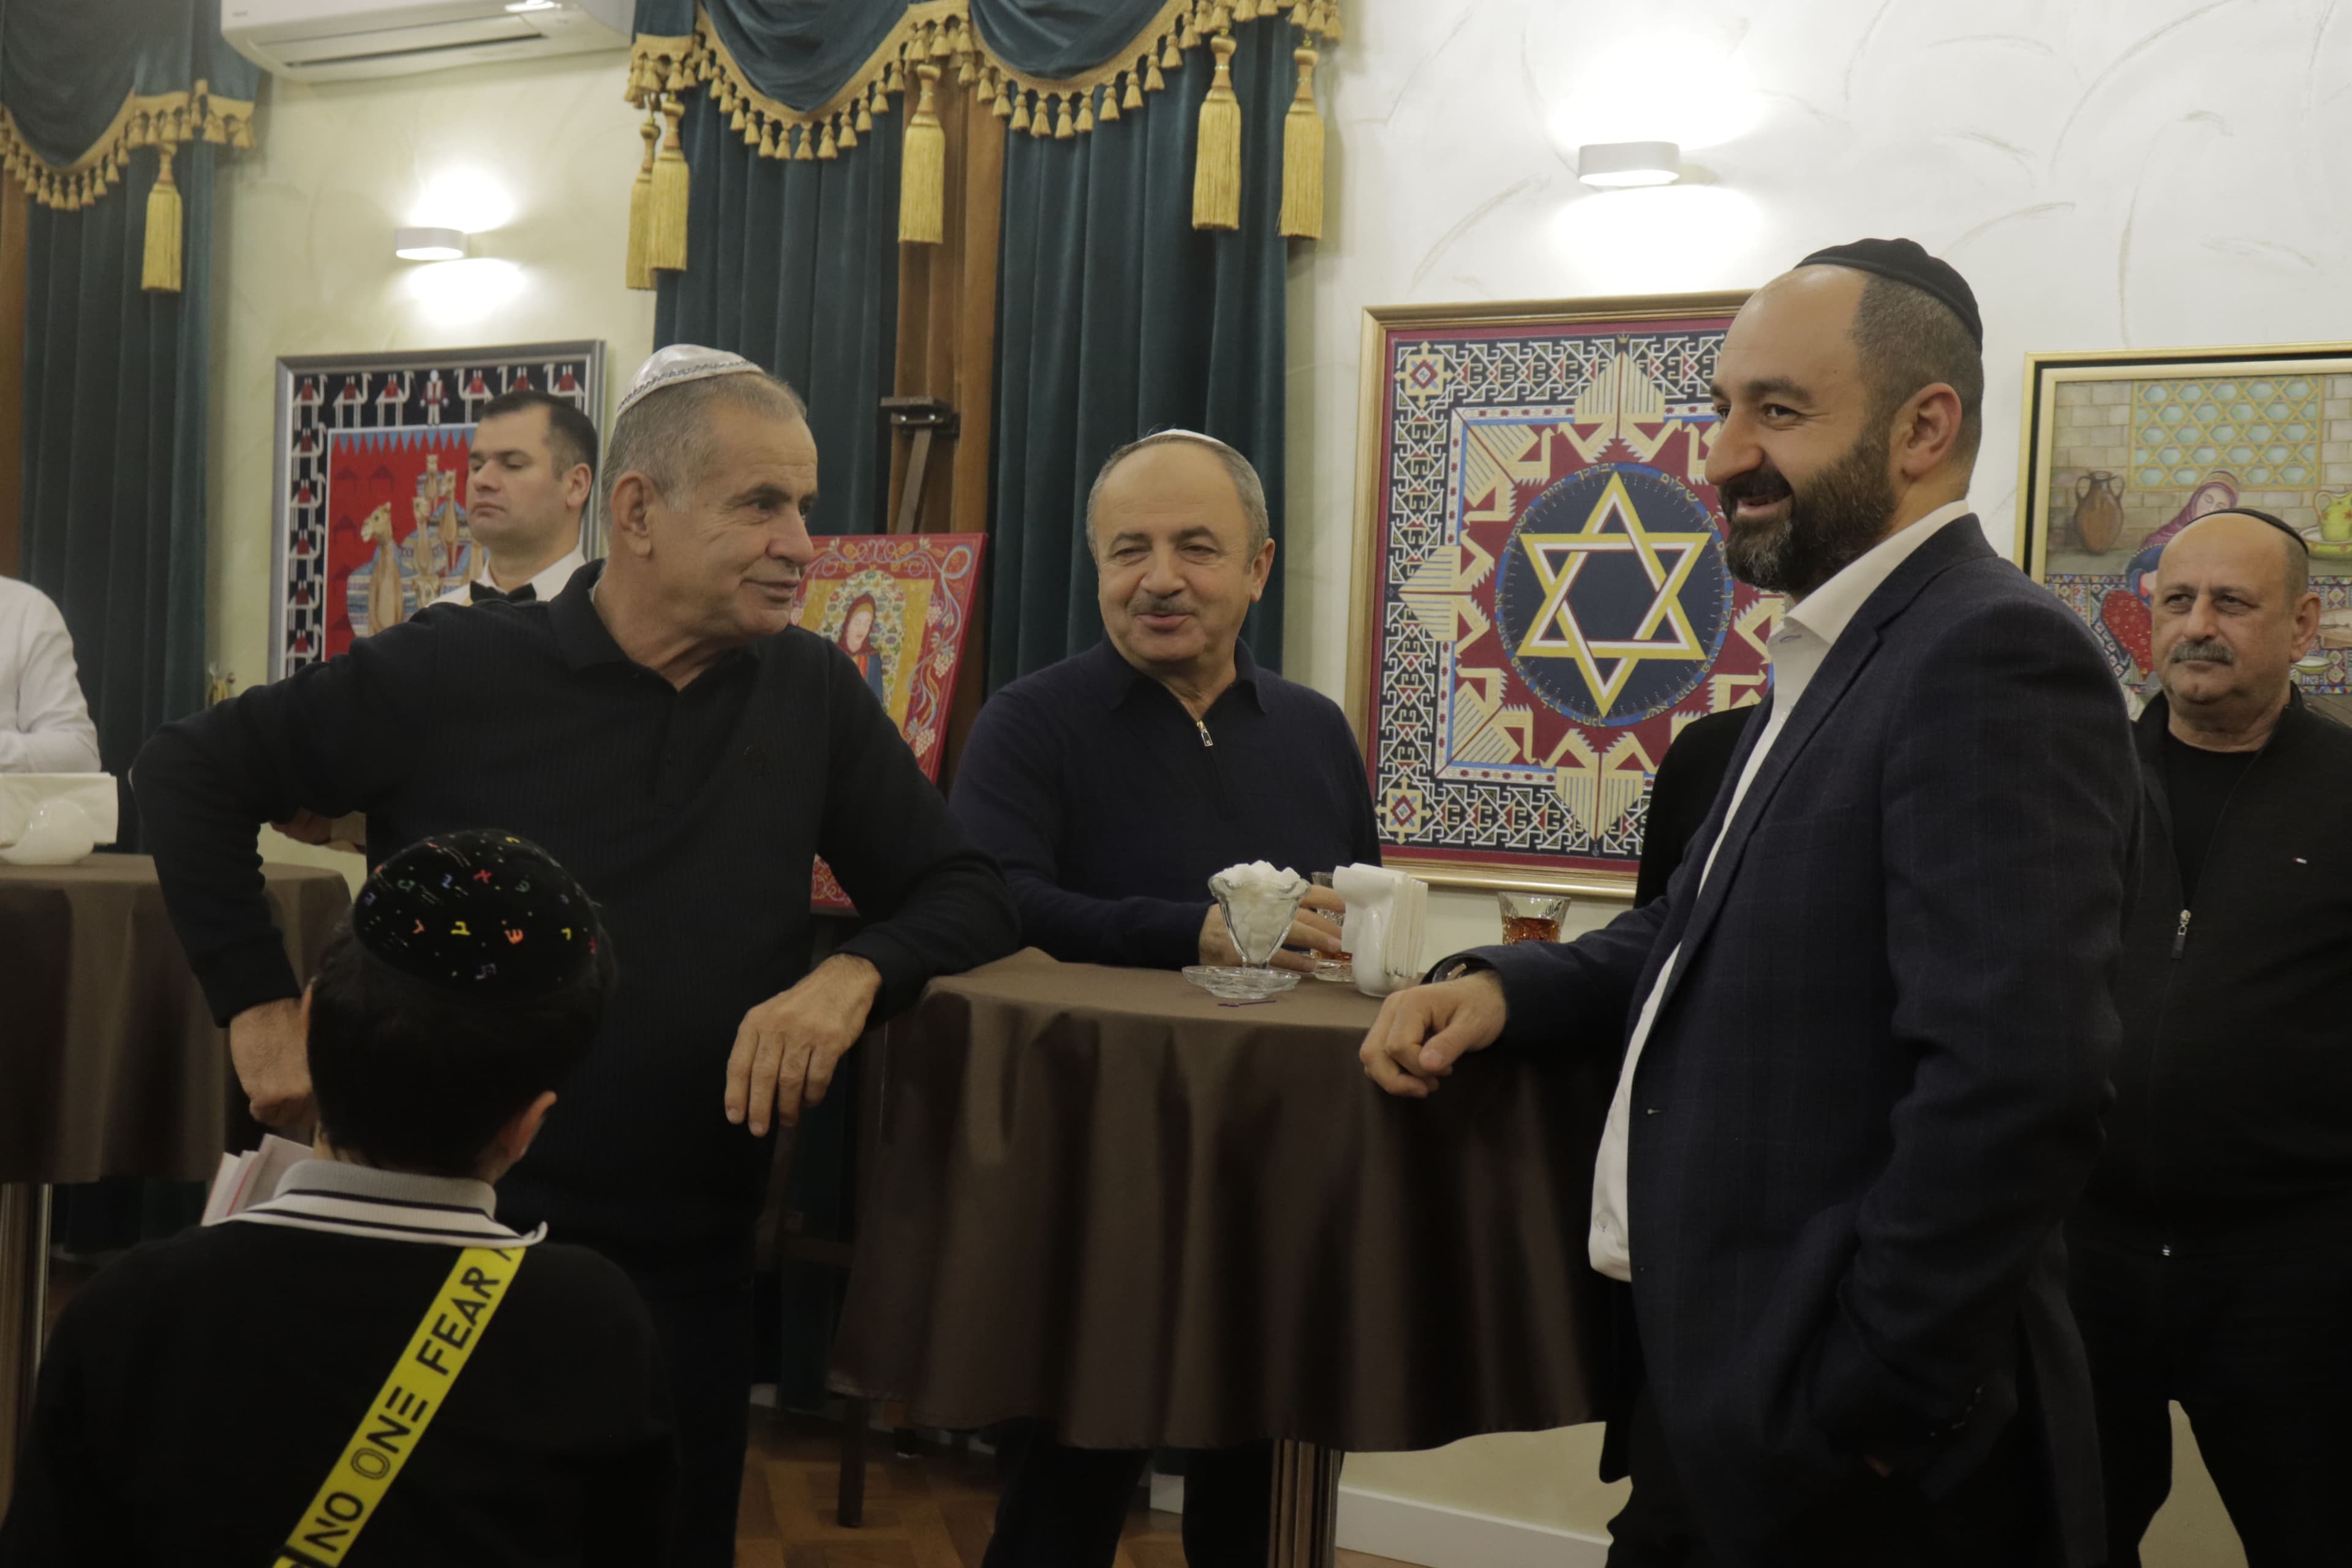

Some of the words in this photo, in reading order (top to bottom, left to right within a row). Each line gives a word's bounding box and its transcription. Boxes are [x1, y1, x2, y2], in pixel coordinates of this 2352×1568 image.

[1660, 472, 1700, 502] שלום
[304, 1491, 364, 1553] NO
[350, 1386, 429, 1480] ONE
[415, 1267, 500, 1376] FEAR
